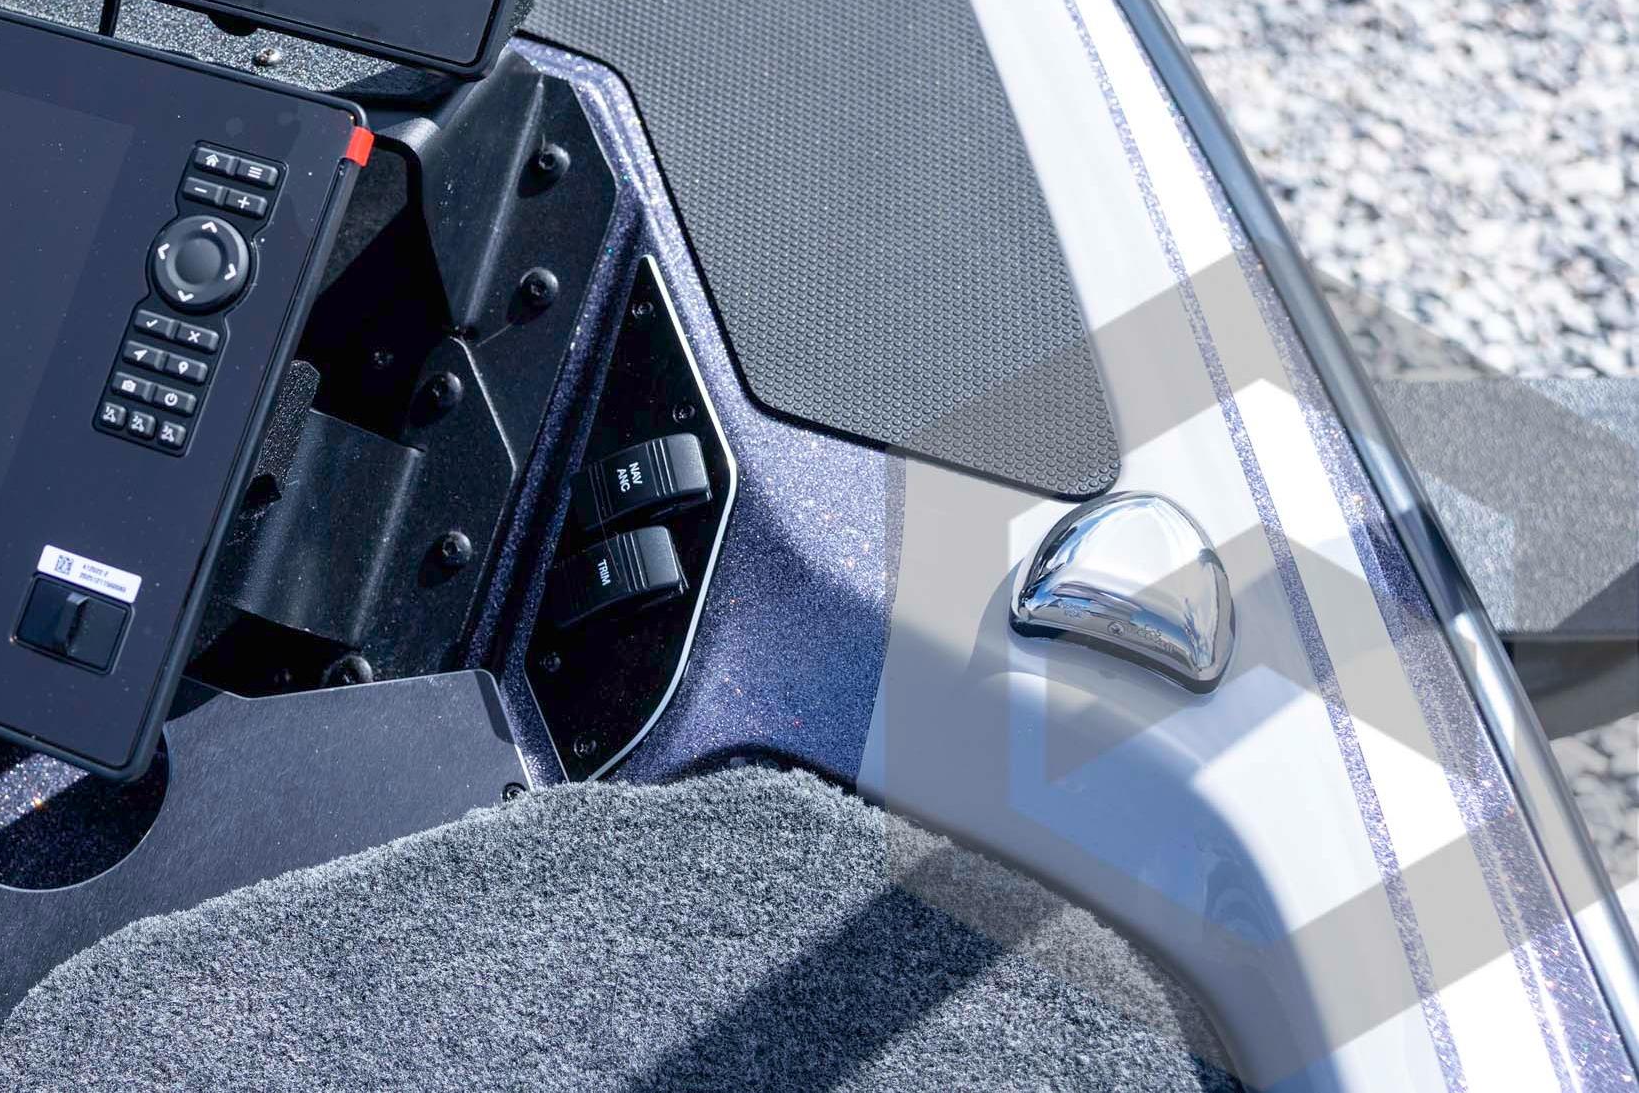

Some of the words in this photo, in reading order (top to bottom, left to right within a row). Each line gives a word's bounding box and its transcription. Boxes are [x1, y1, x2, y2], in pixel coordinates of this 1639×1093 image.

[617, 468, 631, 493] ANC
[629, 461, 643, 485] NAV
[597, 558, 611, 587] TRIM
